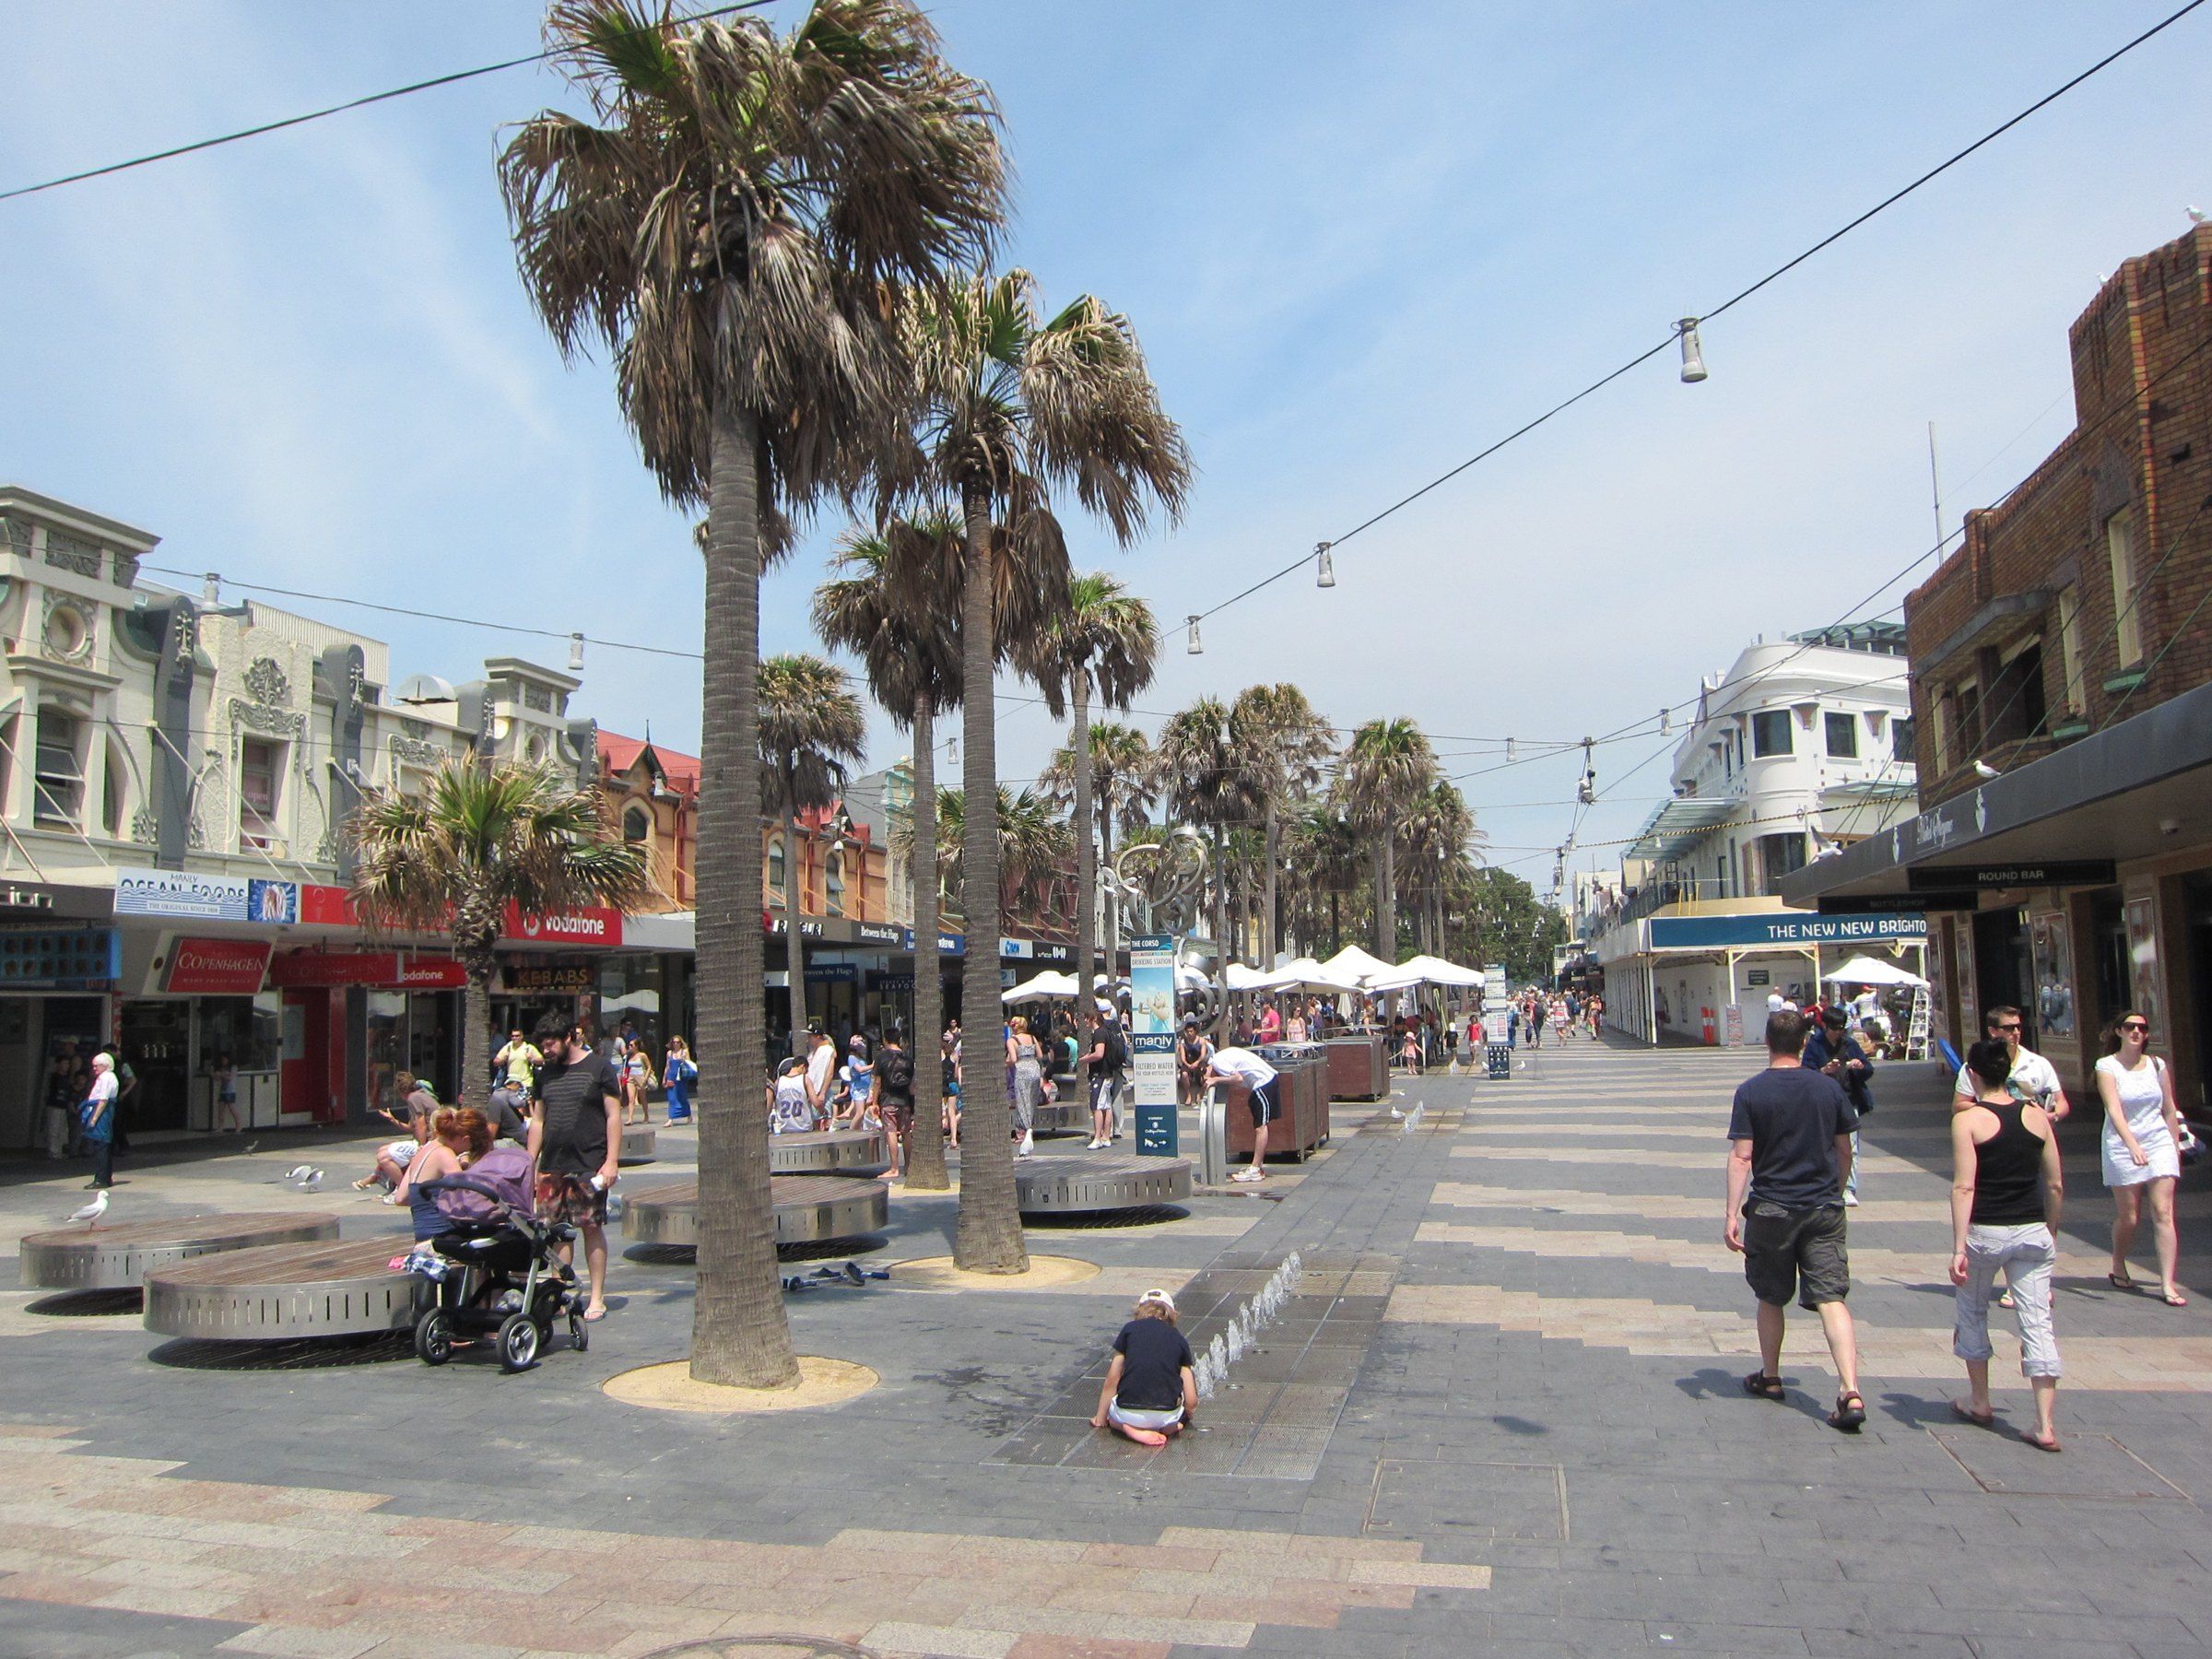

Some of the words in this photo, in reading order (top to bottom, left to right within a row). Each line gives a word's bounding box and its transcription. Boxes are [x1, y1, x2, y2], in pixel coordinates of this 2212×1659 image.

[170, 873, 198, 884] MANLY
[1978, 872, 2018, 882] ROUND
[2020, 869, 2044, 880] BAR
[546, 912, 605, 935] vodafone
[1767, 924, 1797, 939] THE
[1801, 923, 1836, 937] NEW
[1841, 921, 1874, 935] NEW
[1878, 919, 1927, 935] BRIGHTO
[860, 924, 879, 938] Between
[888, 928, 900, 944] Flags
[1141, 939, 1159, 947] CORSO
[178, 951, 264, 971] COPENHAGEN
[402, 971, 443, 982] odafone
[517, 969, 588, 985] KEBABS
[835, 967, 853, 977] Flags
[1135, 1035, 1172, 1049] manly
[1135, 1062, 1157, 1070] FILTERED
[1157, 1062, 1174, 1070] WATER
[780, 1100, 804, 1119] 20
